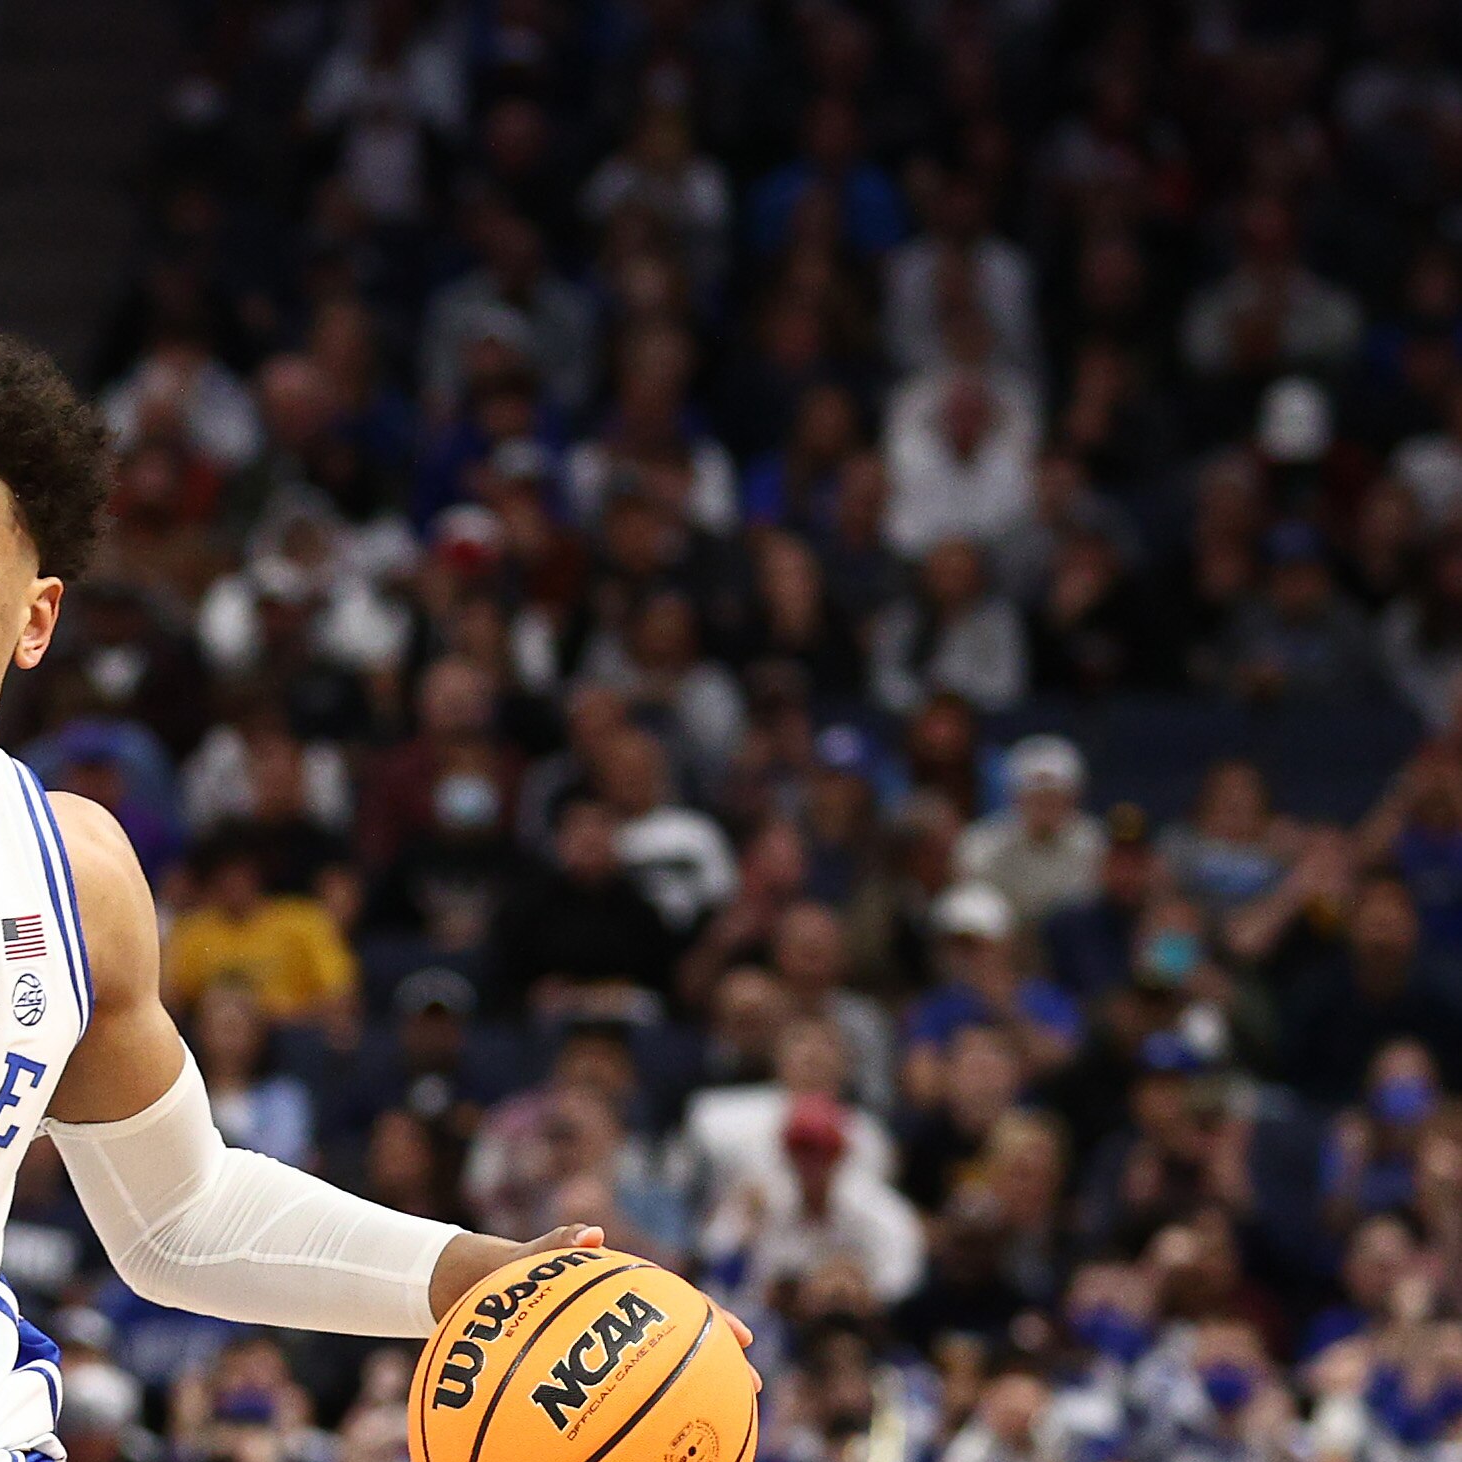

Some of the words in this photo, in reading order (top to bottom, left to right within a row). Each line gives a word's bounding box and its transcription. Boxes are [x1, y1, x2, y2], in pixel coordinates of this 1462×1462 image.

[17, 989, 44, 1003] ACC
[504, 1311, 528, 1337] EVO
[528, 1286, 553, 1308] NXT
[530, 1290, 667, 1432] NCAA
[566, 1384, 617, 1441] OFFICIAL
[615, 1348, 649, 1381] GAME
[648, 1325, 677, 1348] BALL
